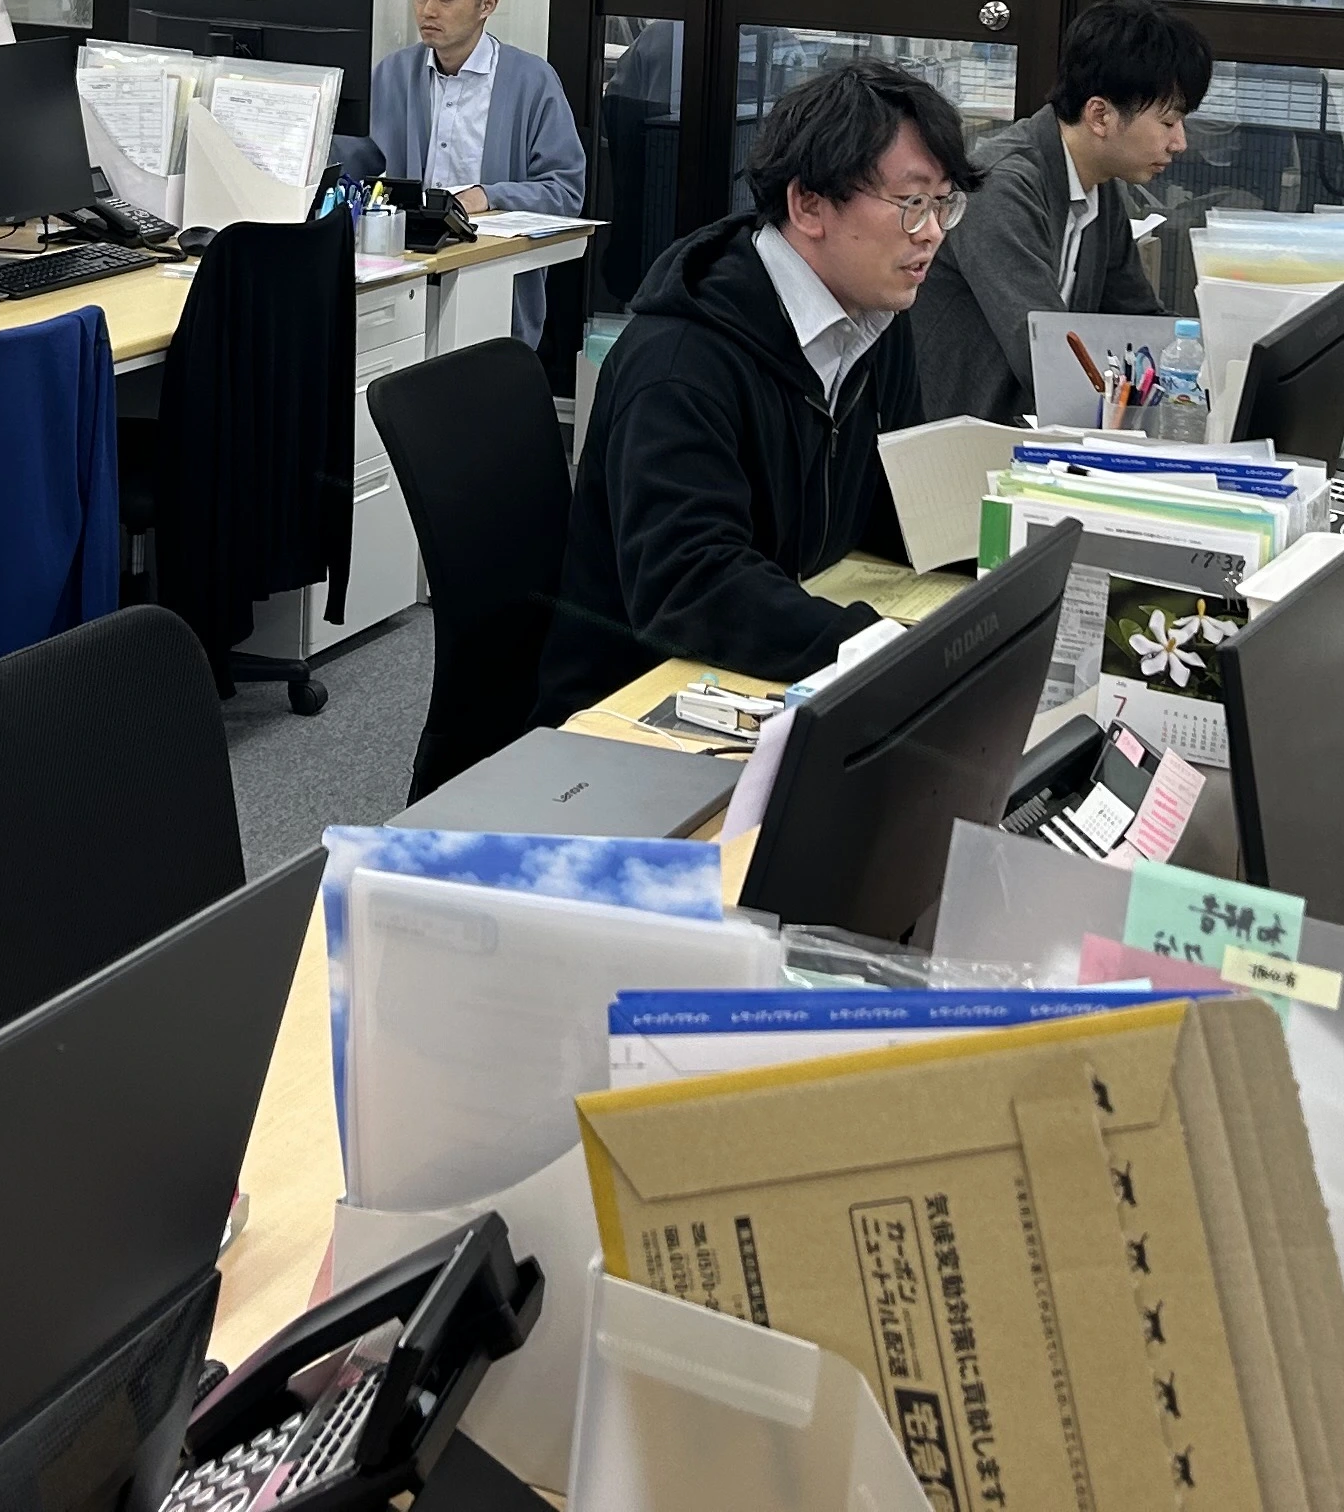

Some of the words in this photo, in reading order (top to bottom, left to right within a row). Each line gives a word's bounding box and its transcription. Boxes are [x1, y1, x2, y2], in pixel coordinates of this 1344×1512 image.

[1189, 551, 1246, 573] 17:30
[924, 1191, 1008, 1512] 気候変動対策に貢献します
